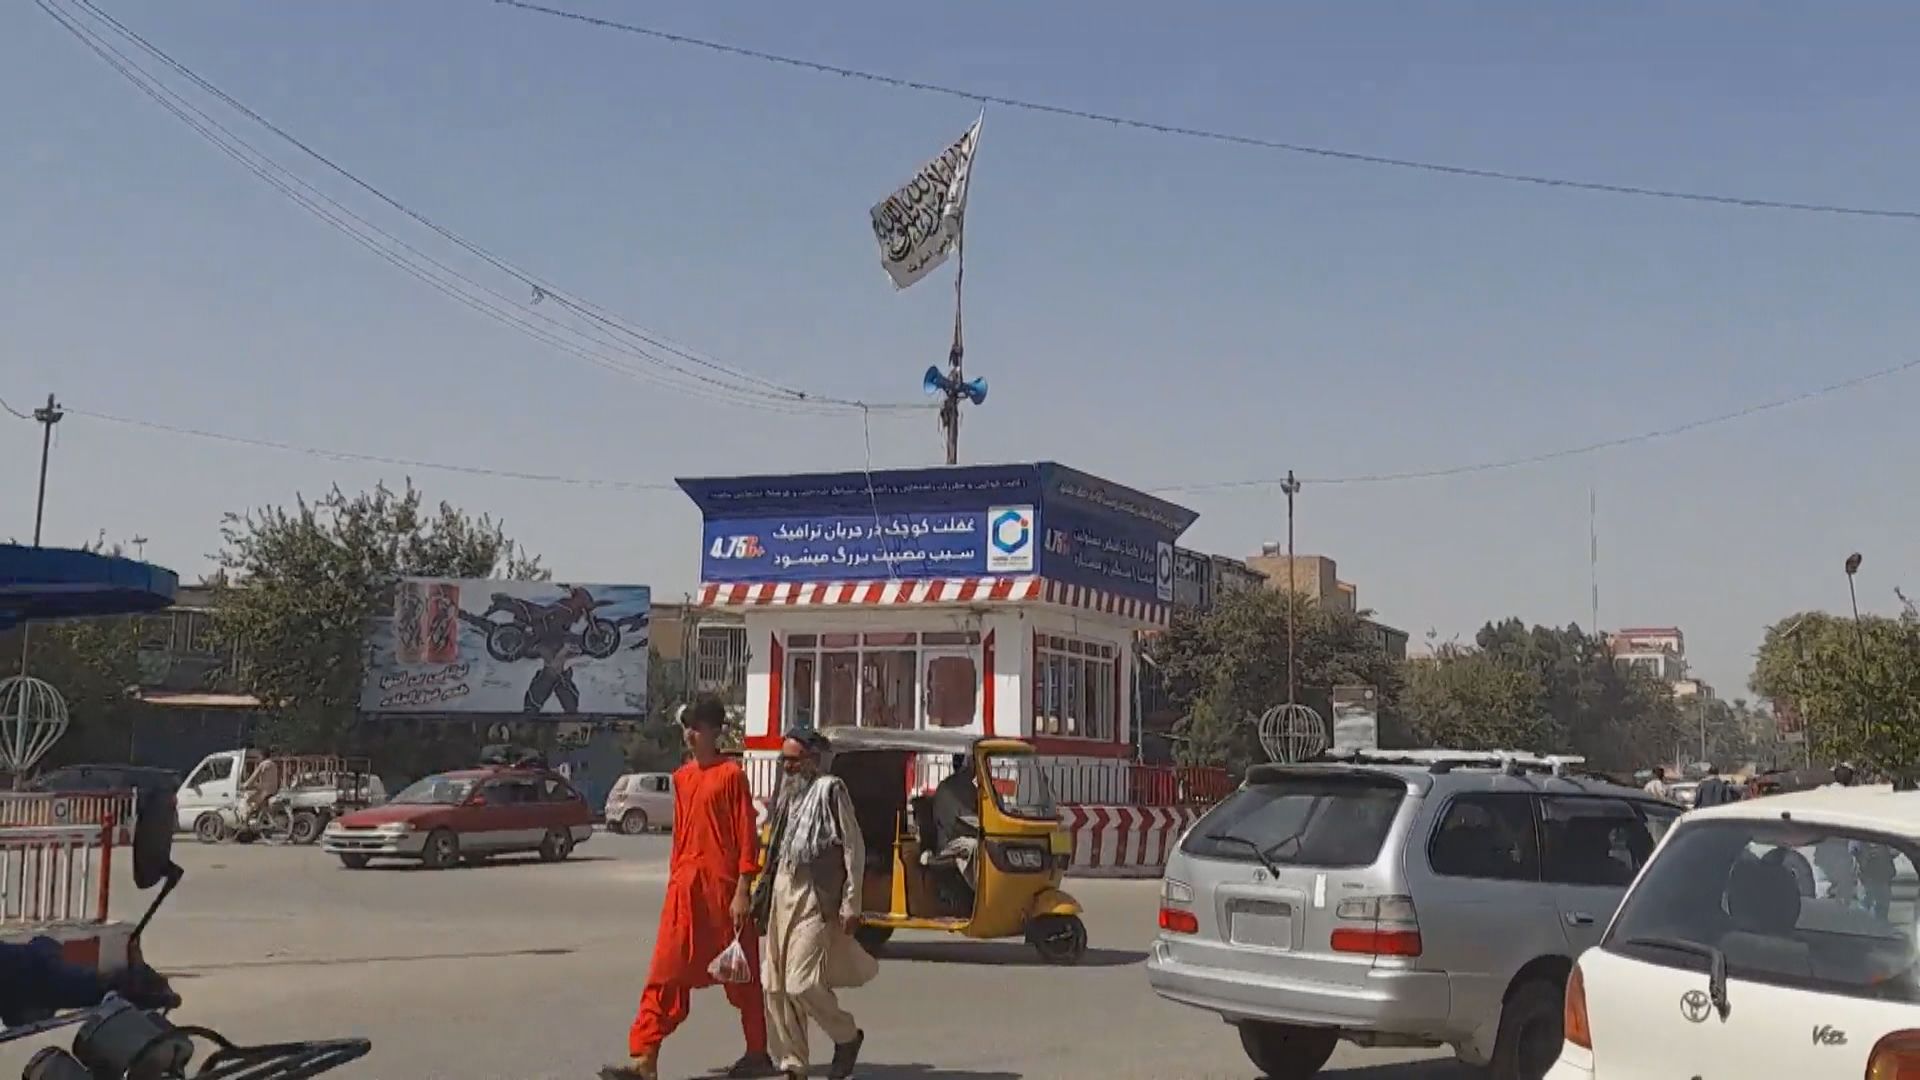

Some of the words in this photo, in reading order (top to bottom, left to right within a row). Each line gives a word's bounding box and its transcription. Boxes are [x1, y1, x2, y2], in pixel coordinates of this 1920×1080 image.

[772, 523, 822, 542] ترافیک
[824, 522, 863, 540] جریان
[866, 521, 882, 539] در
[884, 518, 929, 539] کوچک
[932, 517, 976, 534] غفلت
[773, 547, 829, 569] میشود
[831, 546, 869, 567] بزرگ
[871, 548, 926, 565] مصیبت
[928, 549, 976, 563] سبب
